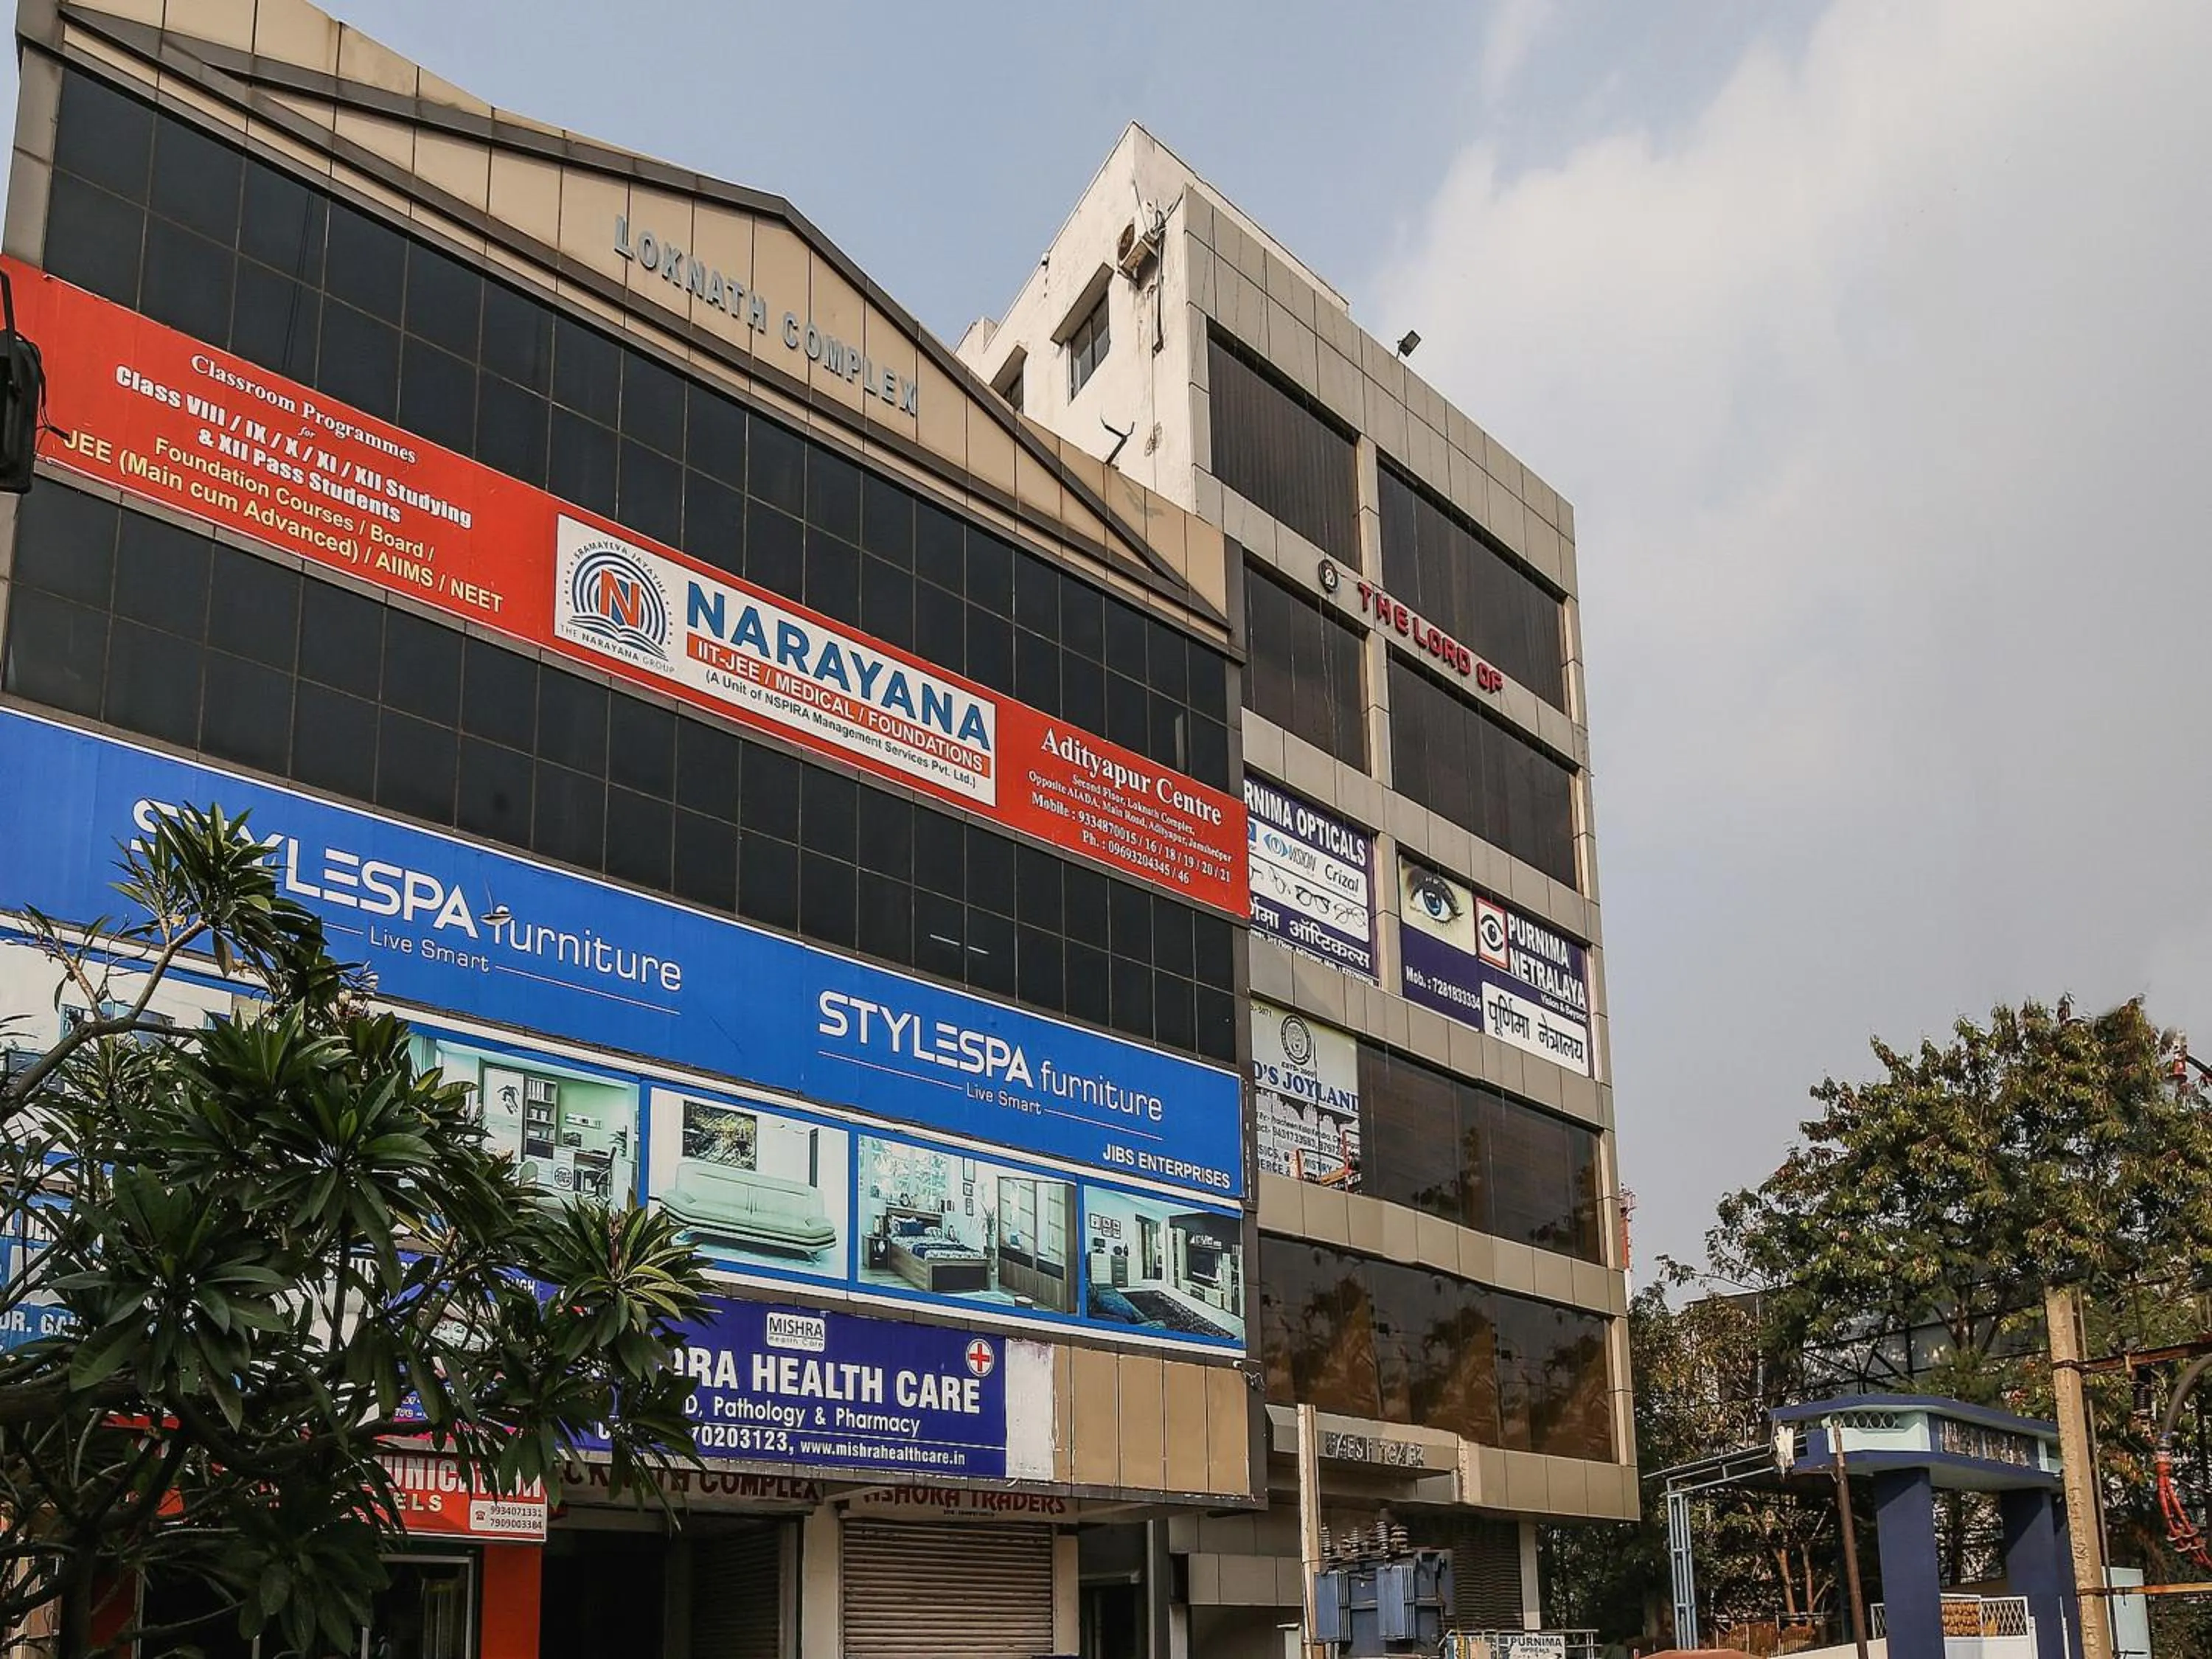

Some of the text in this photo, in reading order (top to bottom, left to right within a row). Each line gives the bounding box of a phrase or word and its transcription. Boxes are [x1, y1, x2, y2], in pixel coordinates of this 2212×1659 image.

[614, 215, 917, 417] LOKNATH COMPLEX
[191, 355, 417, 464] Classroom Programmes
[298, 426, 316, 439] for
[116, 364, 181, 408] Class
[187, 394, 226, 427] VIII
[246, 419, 267, 445] IX
[285, 436, 299, 458] X
[316, 450, 337, 473] XI
[354, 465, 381, 491] XII
[386, 479, 472, 529] Studying
[198, 428, 402, 524] & XII Pass Students
[63, 430, 112, 464] JEE
[119, 449, 183, 492] (Main
[189, 481, 239, 513] cum
[243, 500, 359, 564] Advanced)
[375, 552, 434, 588] AIIMS
[451, 577, 504, 613] NEET
[155, 437, 270, 498] Foundation
[275, 487, 354, 532] Courses
[370, 524, 424, 558] Board
[582, 632, 640, 661] NARAYANA
[642, 655, 675, 673] GROUP
[686, 580, 991, 751] NARAYANA
[1357, 581, 1503, 694] THE LORD OF
[698, 640, 760, 681] IIT-JEE
[776, 672, 855, 720] MEDICAL
[869, 712, 984, 772] FOUNDATIONS
[706, 669, 976, 788] (A Unit of NSPIRA Management Services Pvt. Ltd.)
[1029, 771, 1067, 794] Opposite
[1041, 728, 1222, 825] Adityapur Centre
[1072, 774, 1101, 794] Second
[1032, 792, 1069, 816] Mobile
[1146, 838, 1157, 853] 16
[1082, 830, 1099, 847] Ph.
[1296, 808, 1366, 867] OPTICALS
[1325, 863, 1359, 893] Crizal
[369, 925, 490, 973] Live Smart
[1507, 912, 1571, 969] PURNIMA
[1510, 947, 1586, 1010] NETRALAYA
[818, 990, 1163, 1121] STYLESPA furniture
[966, 1082, 1042, 1115] Live Smart
[1102, 1144, 1231, 1189] JIBS ENTERPRISES
[769, 1317, 823, 1338] MISHRA
[752, 1353, 883, 1404] HEALTH
[896, 1370, 980, 1414] CARE
[714, 1394, 806, 1427] Pathology
[815, 1406, 827, 1426] &
[835, 1408, 921, 1439] Pharmacy
[799, 1439, 966, 1466] www.mishrahealthcare.in
[1512, 1636, 1562, 1646] PURNIMA
